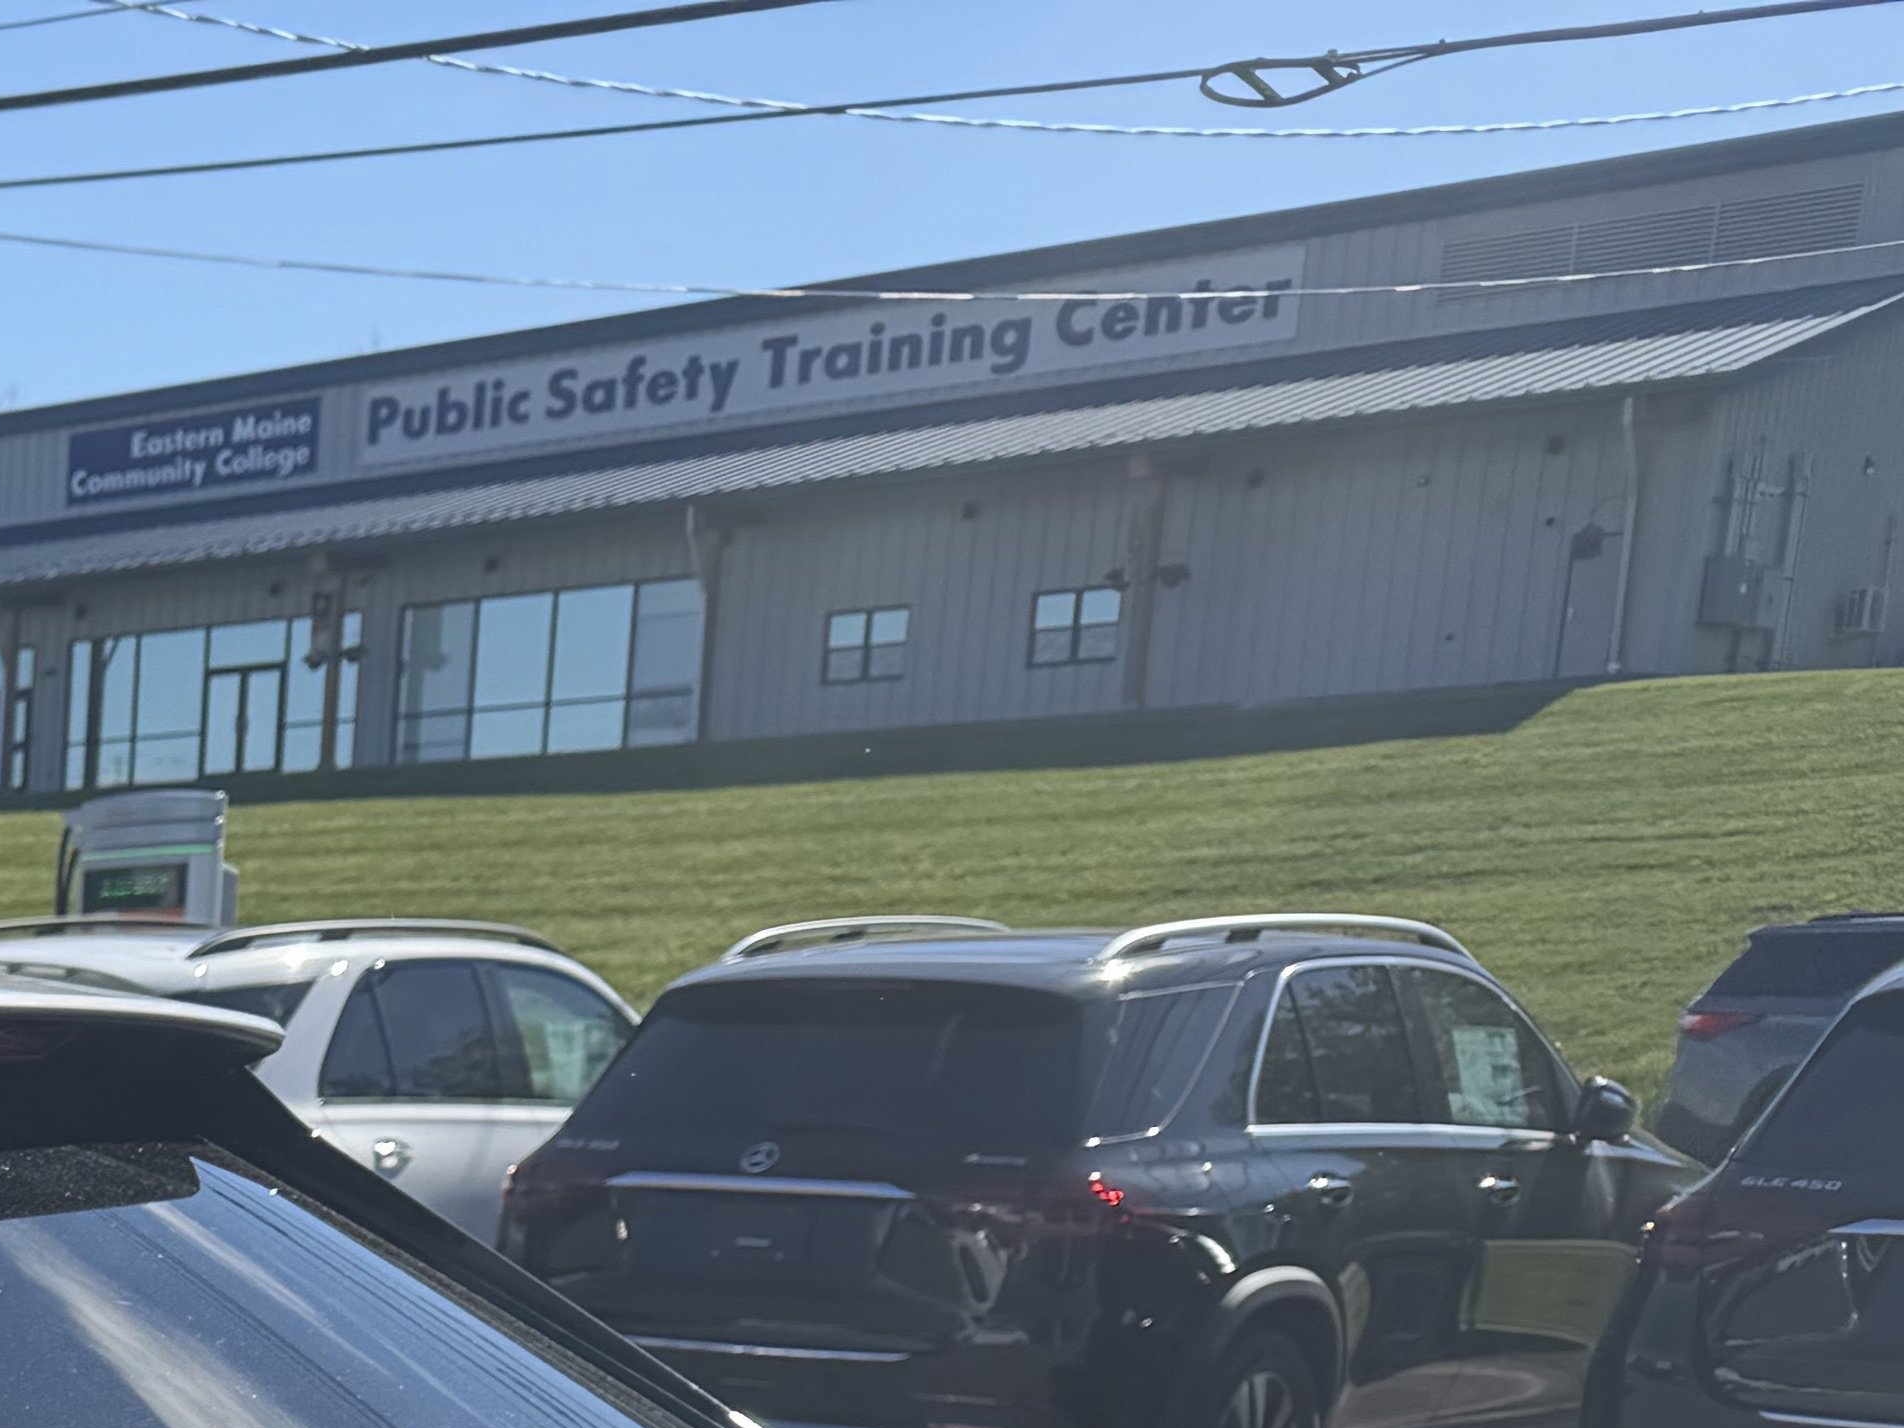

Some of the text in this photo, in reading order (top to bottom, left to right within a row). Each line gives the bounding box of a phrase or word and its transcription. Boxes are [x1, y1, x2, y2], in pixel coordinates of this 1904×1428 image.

[367, 278, 1292, 446] Public Safety Training Center
[129, 410, 313, 459] Eastern Maine
[70, 444, 311, 497] Community College
